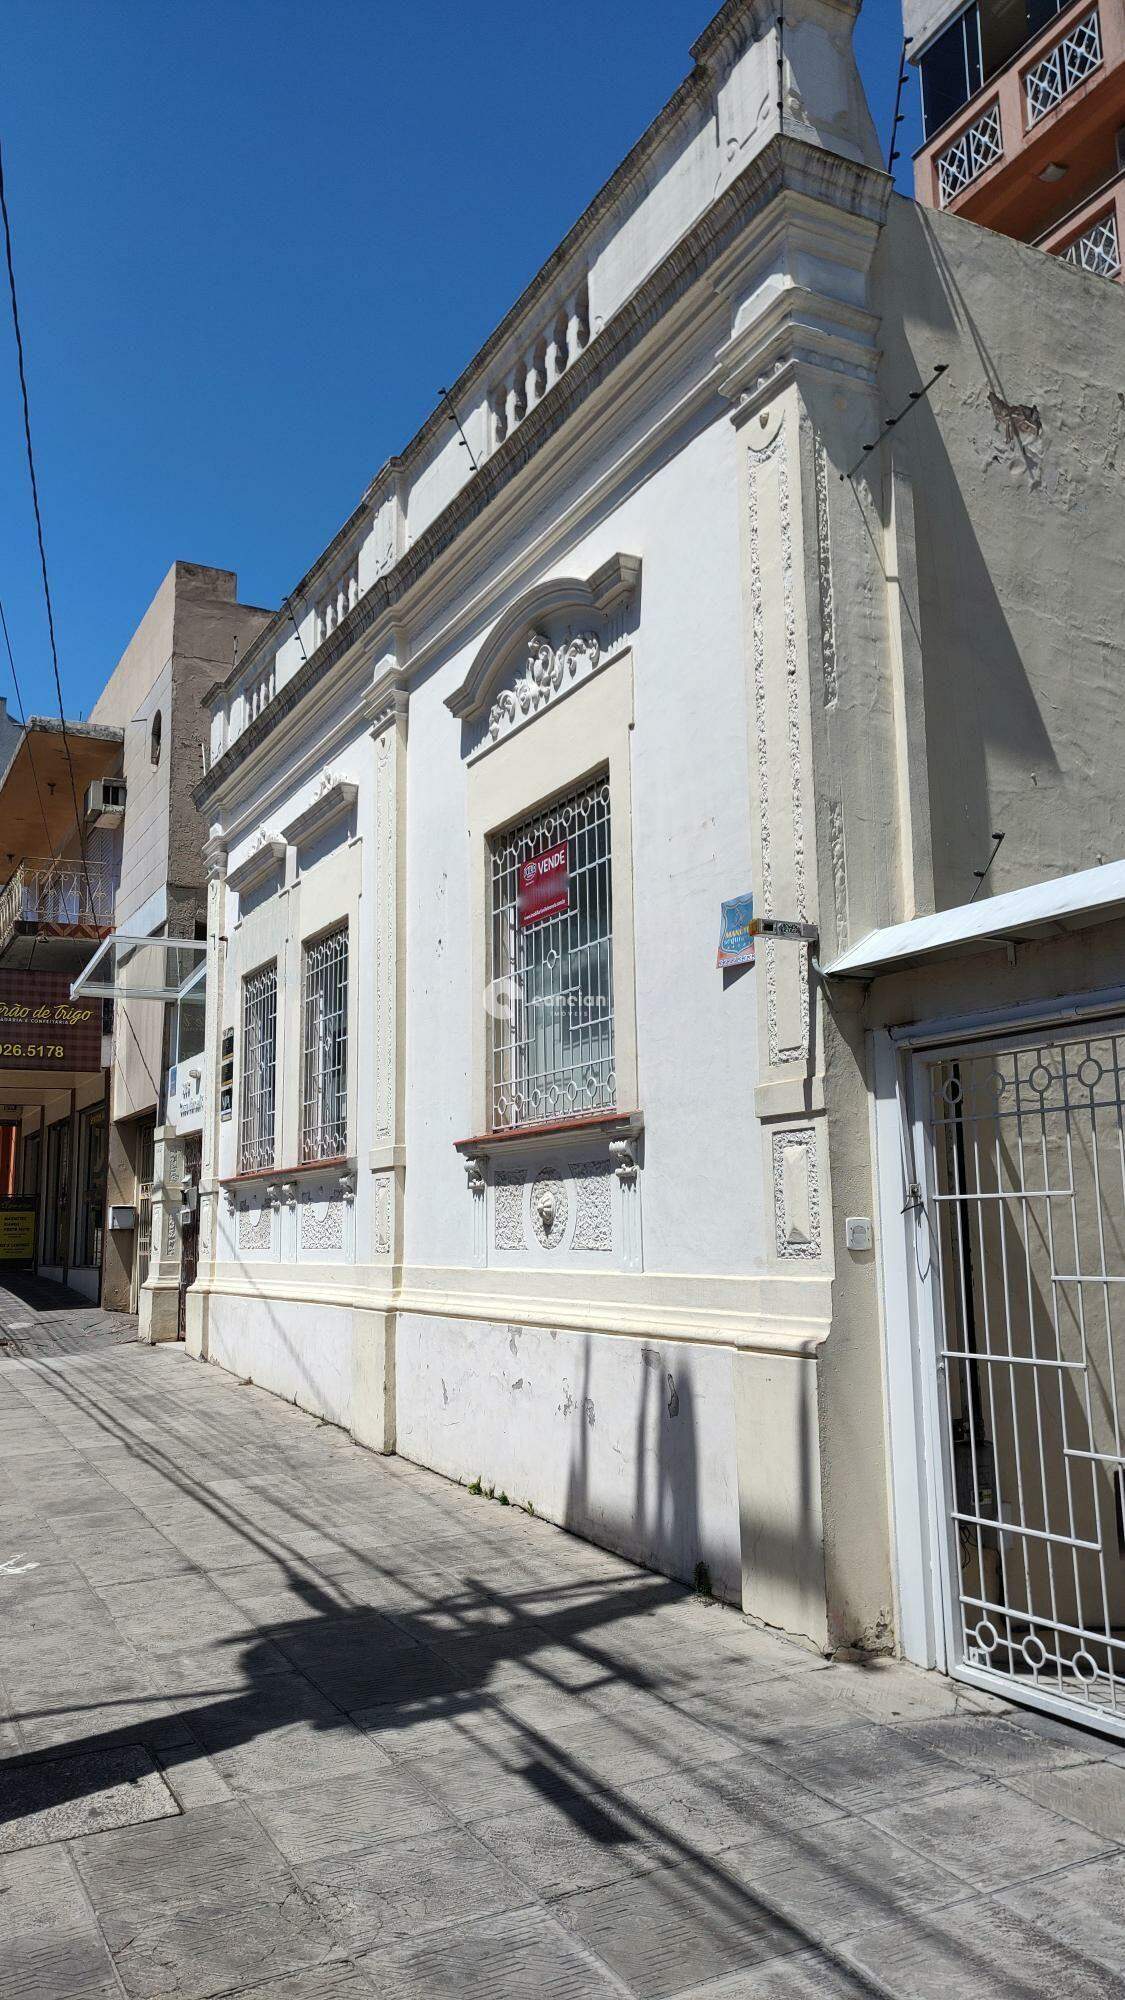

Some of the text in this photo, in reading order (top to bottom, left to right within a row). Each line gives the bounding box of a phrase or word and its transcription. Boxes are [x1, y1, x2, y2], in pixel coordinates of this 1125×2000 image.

[538, 849, 565, 874] VENDE
[32, 1004, 51, 1018] de
[54, 1004, 94, 1025] Trigo
